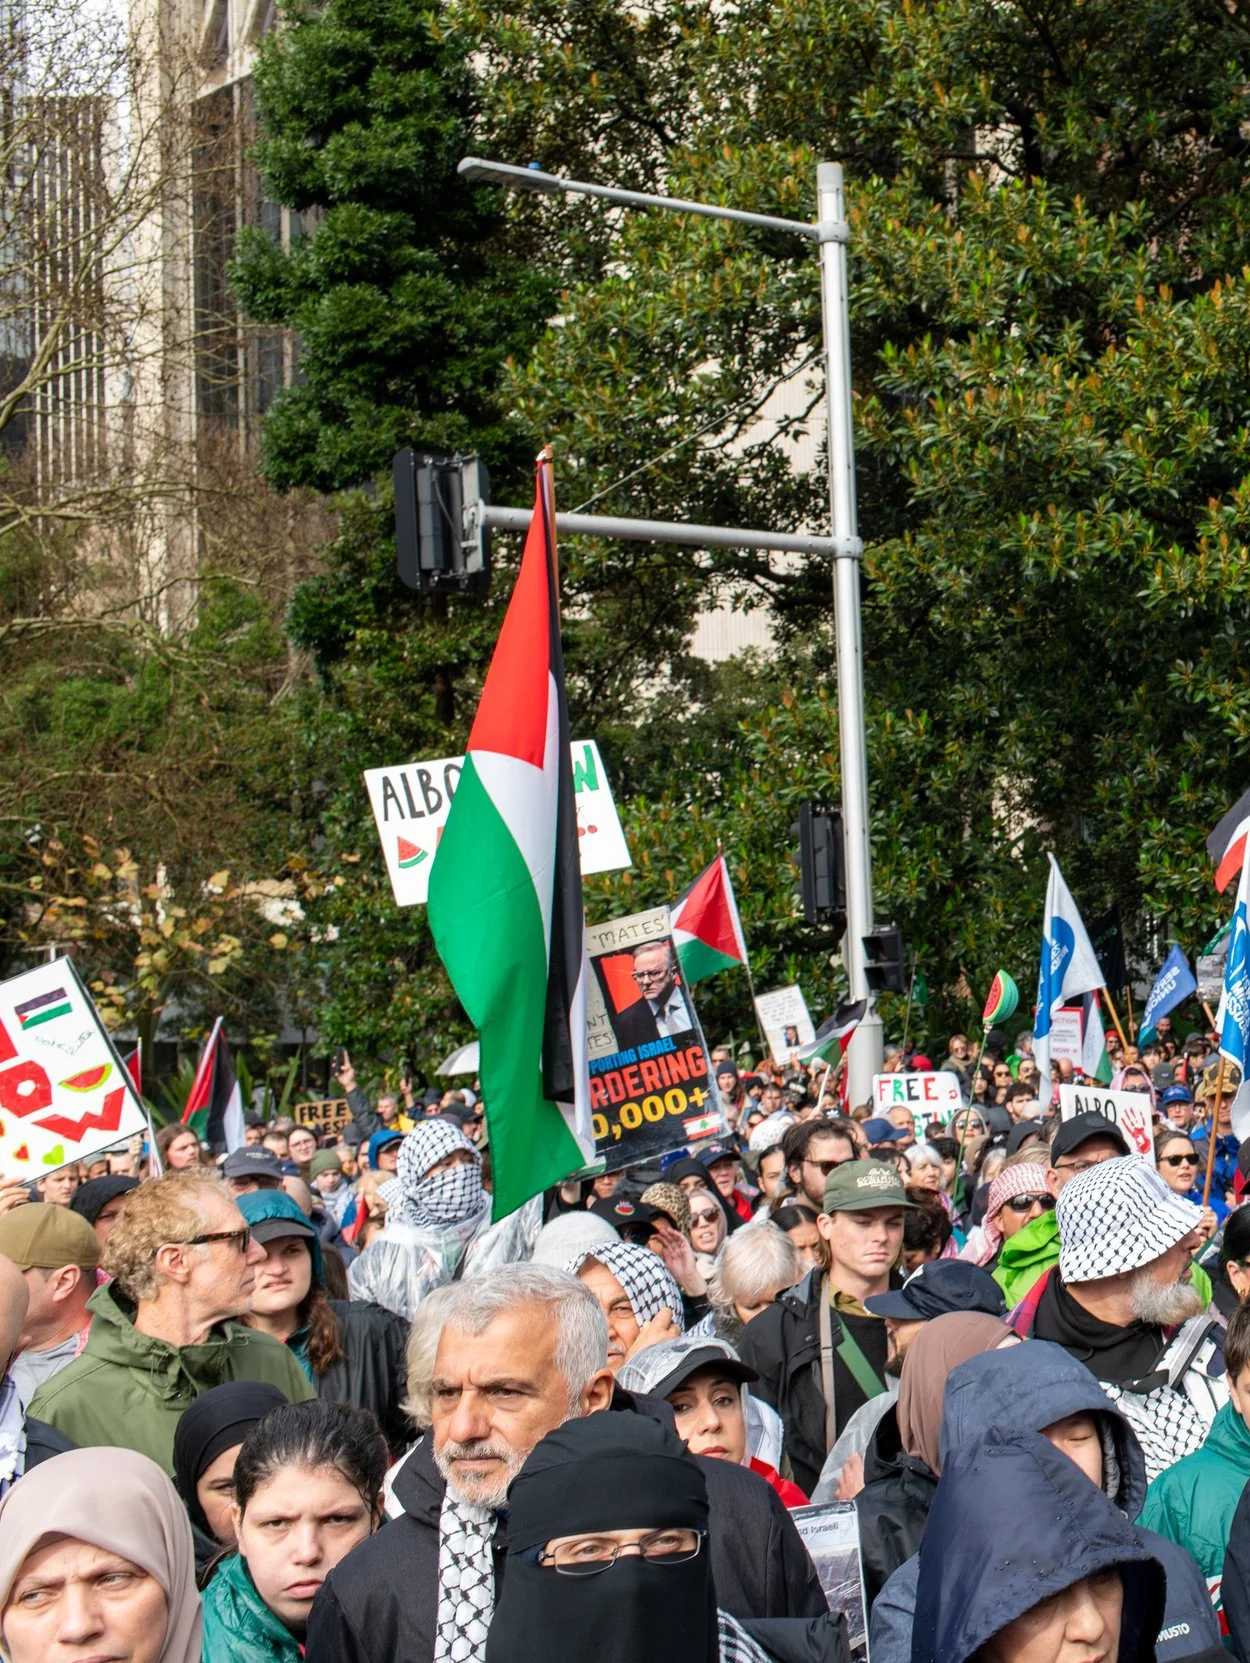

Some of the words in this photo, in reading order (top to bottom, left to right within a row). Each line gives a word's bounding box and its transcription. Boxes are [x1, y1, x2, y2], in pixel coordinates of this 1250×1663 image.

[589, 1048, 637, 1075] PORTING
[637, 1036, 677, 1059] ISRAEL
[589, 1045, 708, 1110] RDERING
[878, 1077, 939, 1101] FREE
[299, 1101, 347, 1122] FREE
[591, 1087, 709, 1141] 0,000+
[810, 1521, 840, 1534] Israeli
